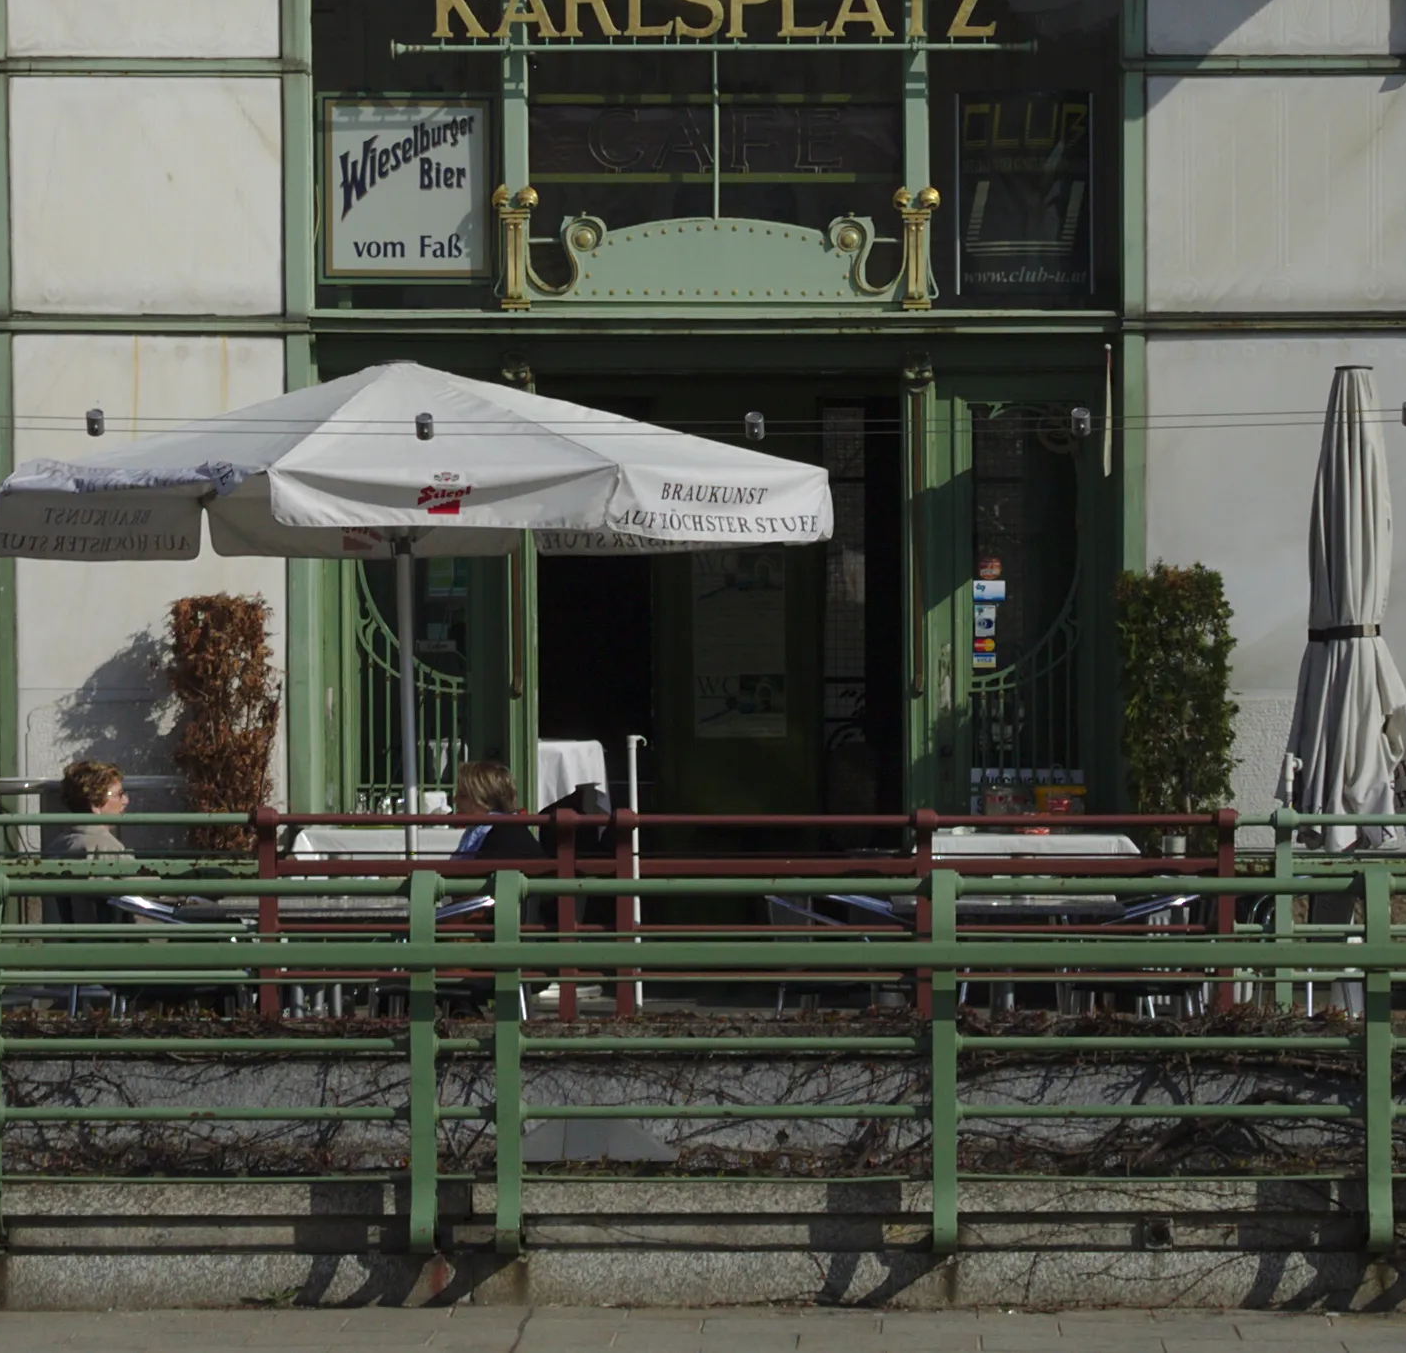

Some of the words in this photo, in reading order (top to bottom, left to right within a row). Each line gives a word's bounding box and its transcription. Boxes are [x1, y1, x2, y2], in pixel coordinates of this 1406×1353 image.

[963, 99, 1088, 151] CLUB
[587, 107, 843, 171] CAFE
[339, 115, 475, 222] Wieselburger
[419, 157, 466, 190] Bier
[353, 240, 405, 258] vom
[419, 233, 462, 258] Faß
[962, 265, 1087, 285] www.club-u.at
[660, 482, 768, 505] BRAUKUNST
[615, 509, 656, 529] AUF
[754, 515, 818, 533] STUFE
[697, 676, 740, 696] WC
